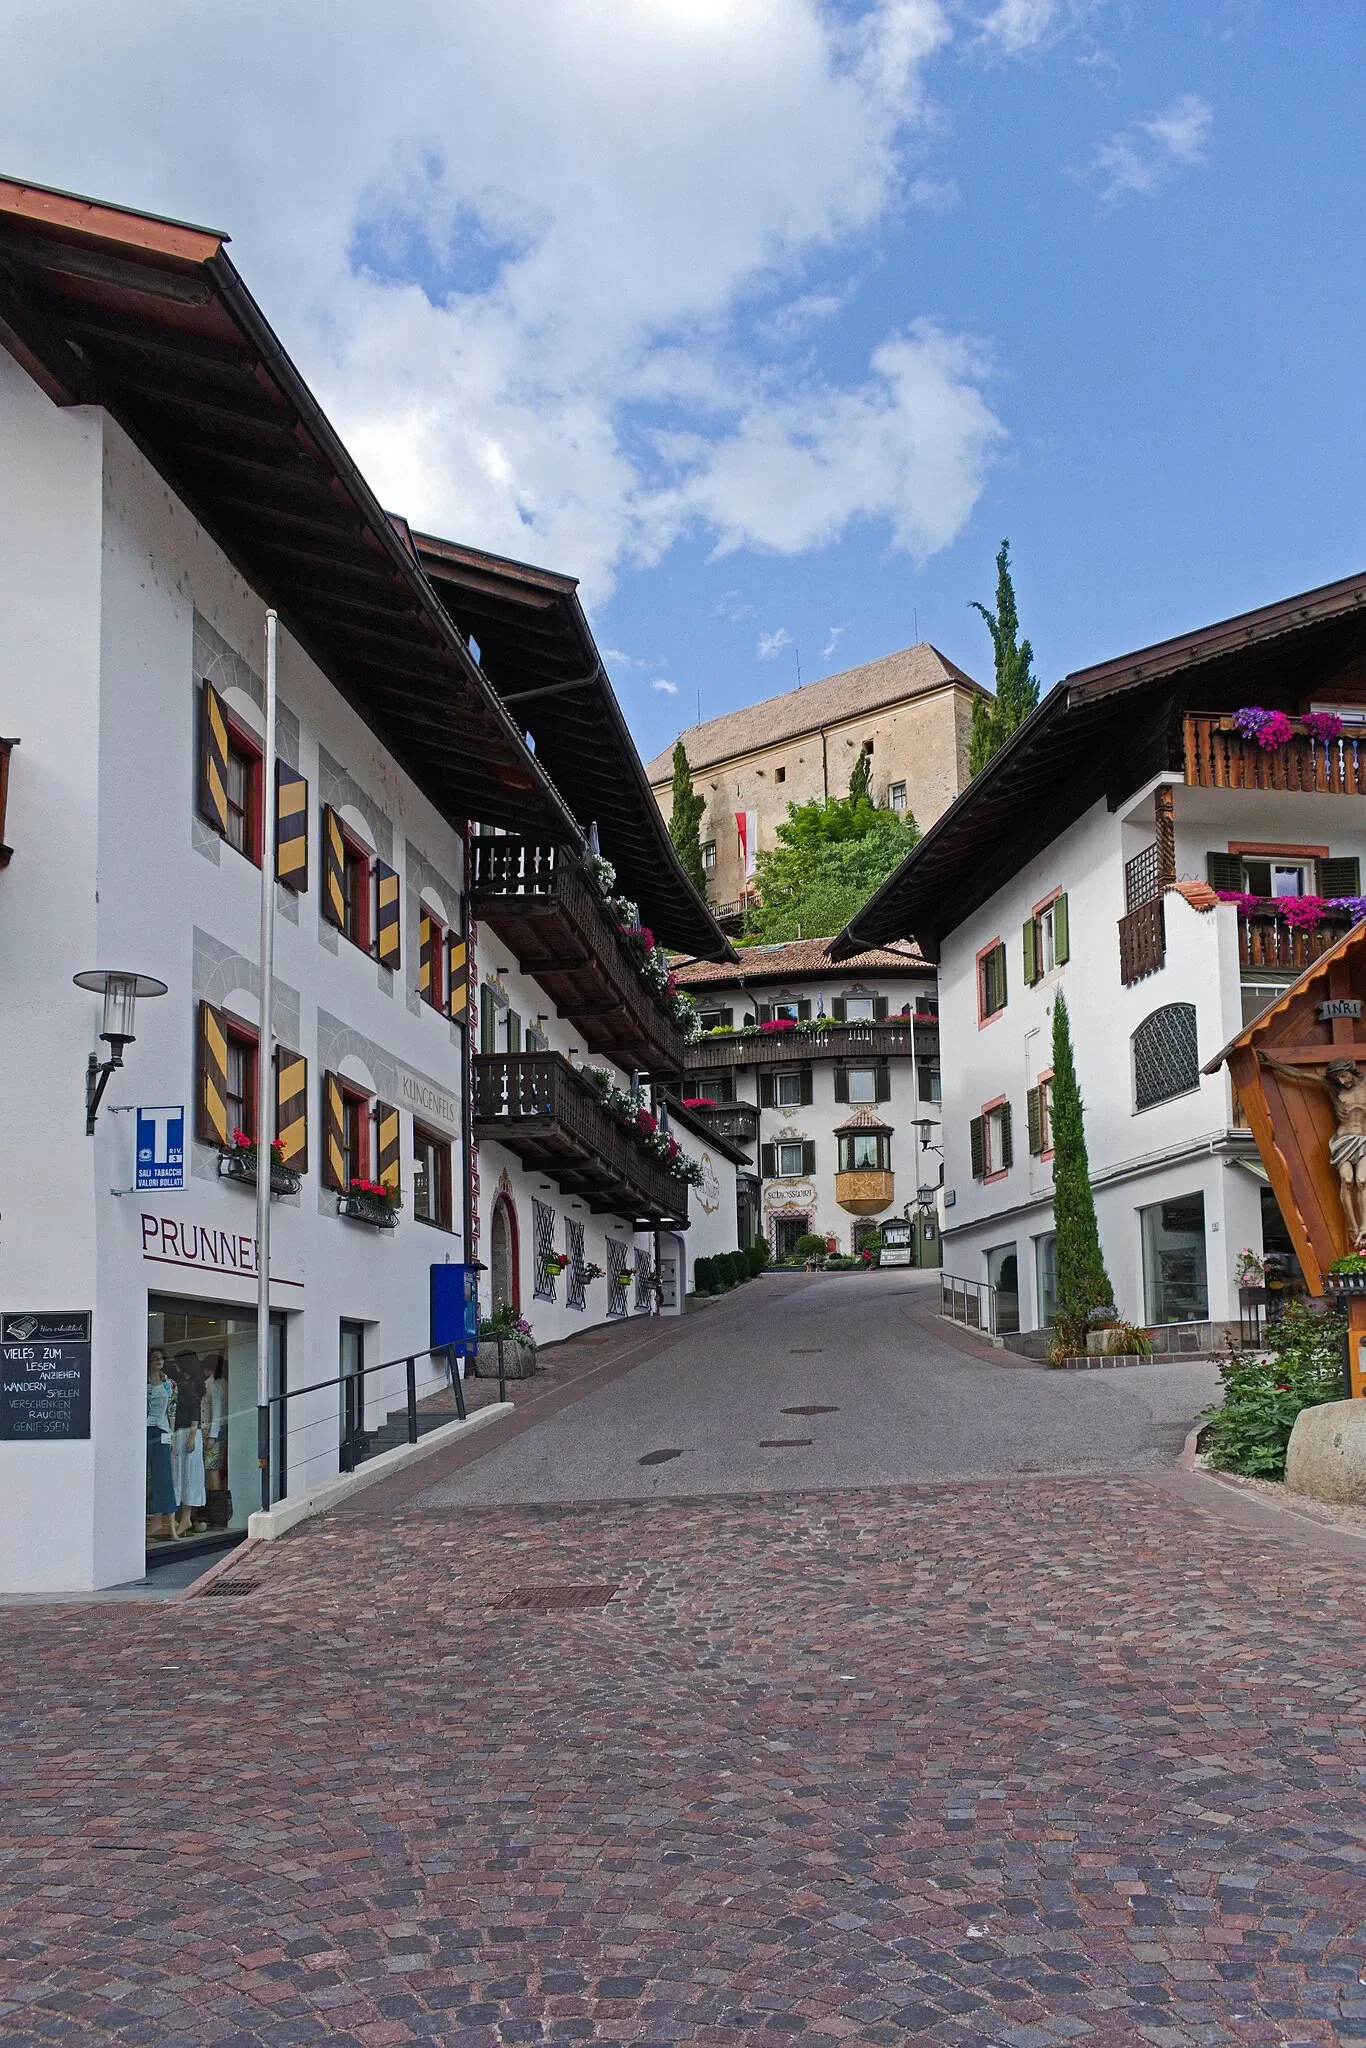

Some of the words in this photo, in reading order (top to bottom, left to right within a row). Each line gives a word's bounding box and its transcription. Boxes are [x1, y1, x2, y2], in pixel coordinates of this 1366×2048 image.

[1326, 1002, 1357, 1015] INRI
[403, 1075, 455, 1123] KLINGENFELS
[141, 1108, 182, 1164] T
[138, 1169, 152, 1177] SALI
[154, 1168, 182, 1177] TABACCHI
[138, 1178, 158, 1187] VALORI
[160, 1178, 182, 1187] BOLLATI
[3, 1347, 35, 1359] VIELES
[42, 1347, 62, 1360] ZUM
[26, 1362, 56, 1372] LESEN
[39, 1371, 80, 1380] ANZIEHEN
[3, 1382, 47, 1392] WANDERN
[9, 1399, 71, 1409] VERSCHENKEN
[28, 1410, 71, 1420] RAUCHEN
